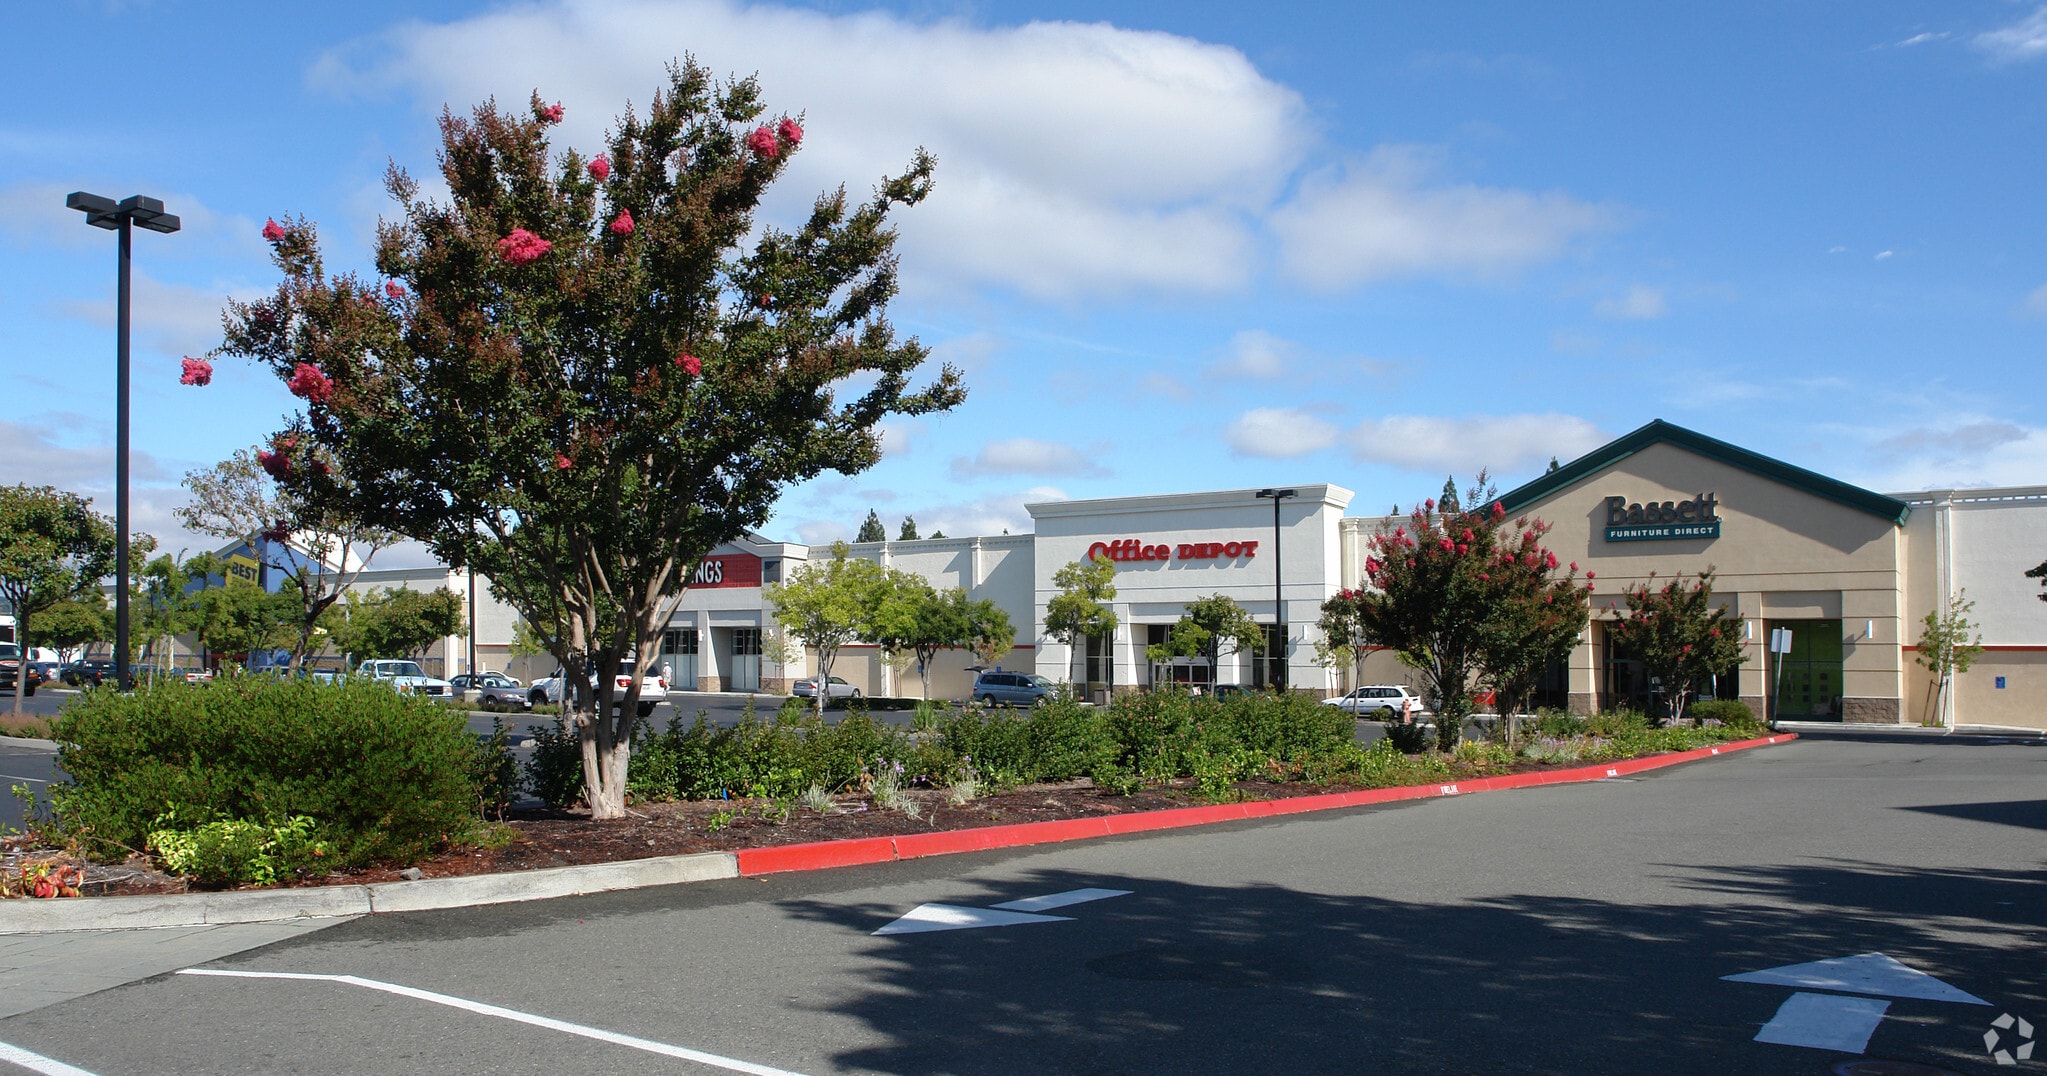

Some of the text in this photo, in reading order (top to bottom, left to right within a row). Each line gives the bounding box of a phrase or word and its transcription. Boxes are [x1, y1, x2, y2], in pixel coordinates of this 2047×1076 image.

[1605, 491, 1719, 526] Bassett
[1610, 527, 1714, 538] FURNITURE DIRECT
[1088, 539, 1259, 562] Office DEPOT
[231, 561, 258, 582] BEST
[691, 560, 722, 584] NGS
